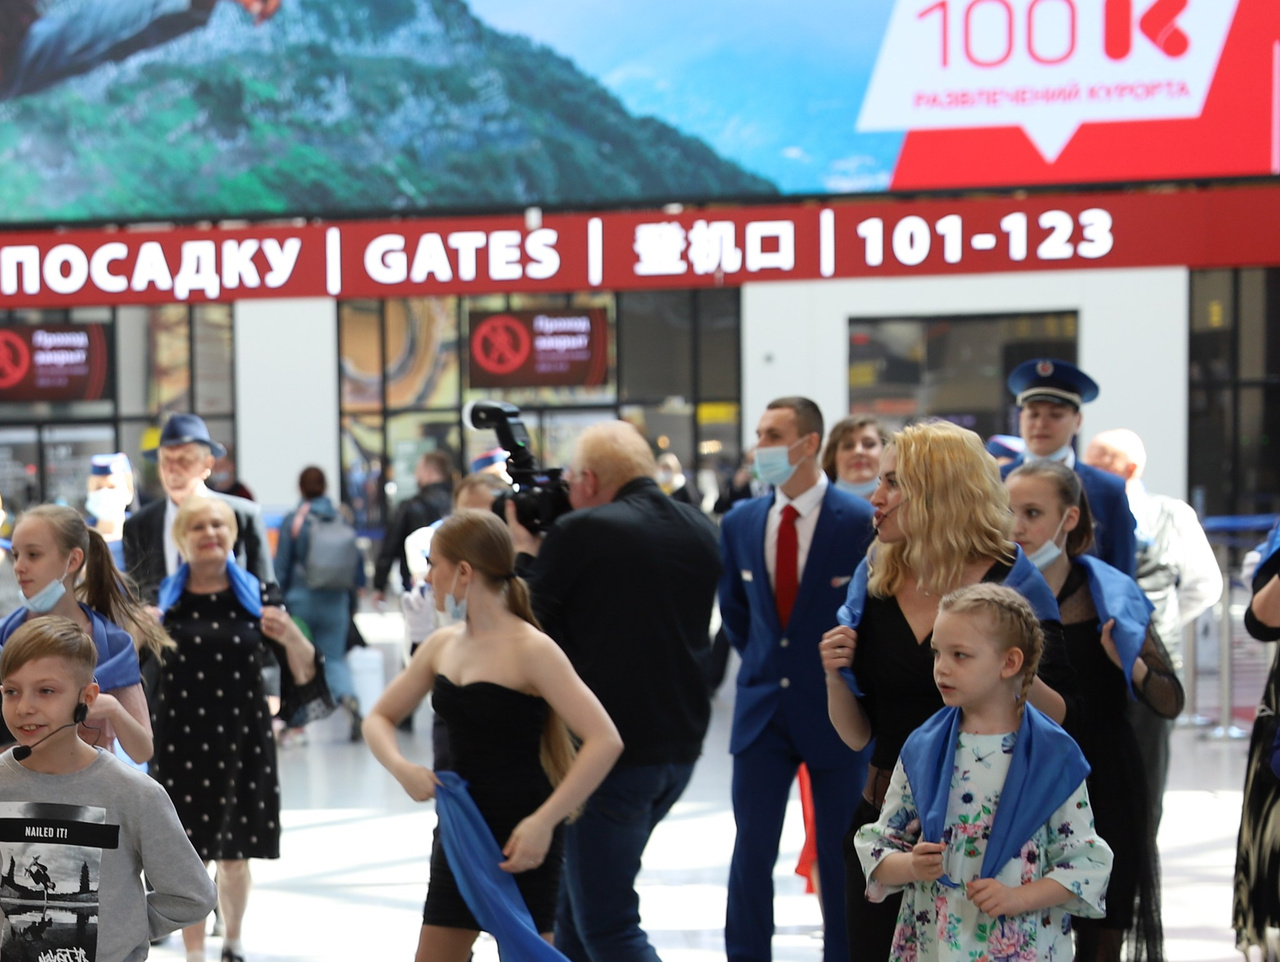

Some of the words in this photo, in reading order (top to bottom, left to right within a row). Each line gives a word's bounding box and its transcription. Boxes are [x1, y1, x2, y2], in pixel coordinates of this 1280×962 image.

[915, 83, 1081, 107] РАЗВЛЕЧЕНИЙ
[1087, 82, 1190, 99] КУРОРТА
[0, 237, 302, 300] ПОСАДКУ
[364, 230, 561, 284] GATES
[633, 220, 795, 276] 登机口
[856, 208, 1114, 266] 101-123
[25, 826, 54, 838] NAILED
[56, 827, 68, 839] IT!
